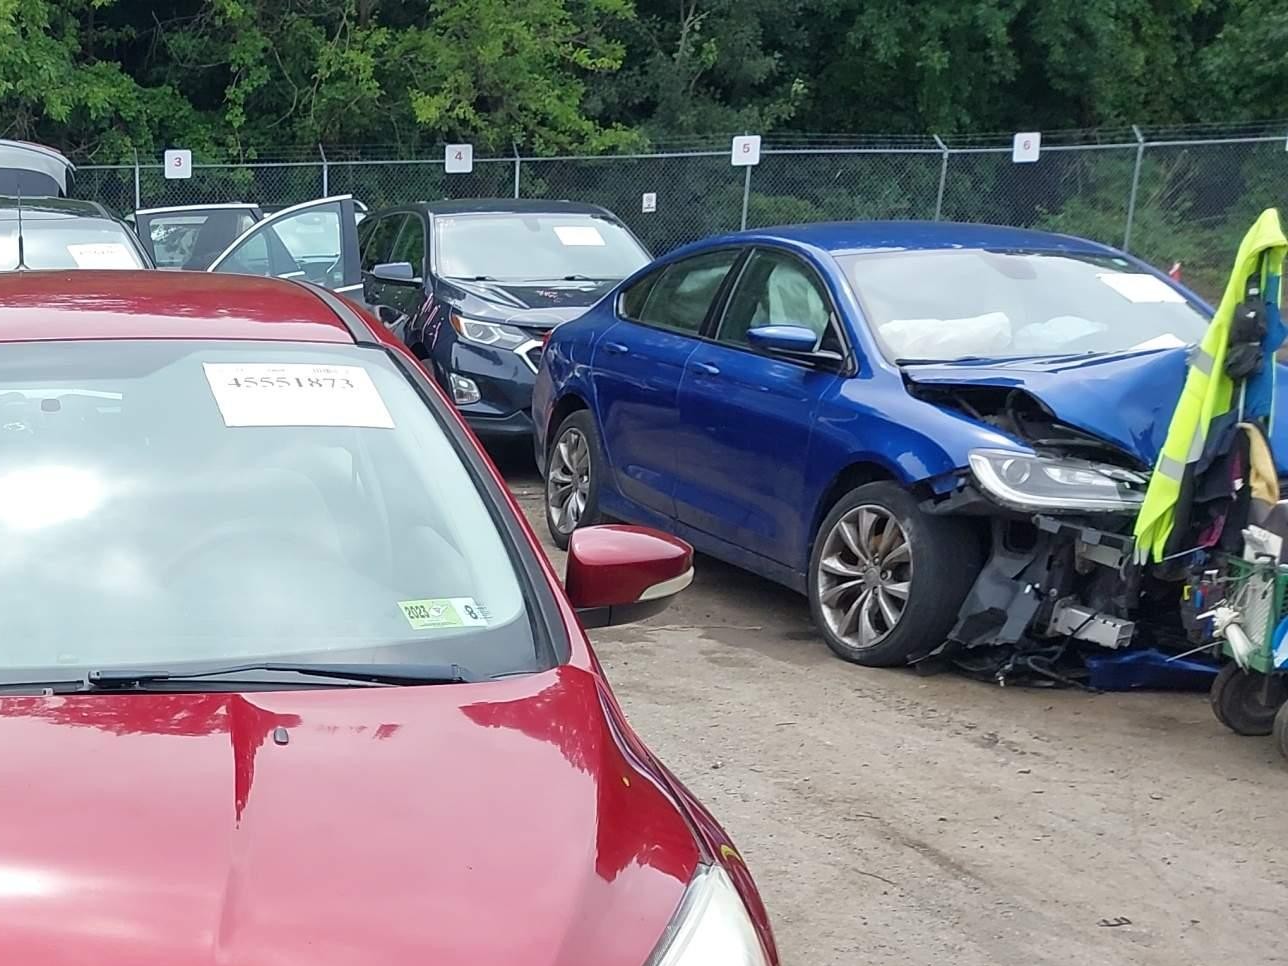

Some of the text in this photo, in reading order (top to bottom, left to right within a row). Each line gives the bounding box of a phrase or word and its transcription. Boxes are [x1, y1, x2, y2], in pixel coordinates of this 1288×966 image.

[743, 143, 751, 153] 5
[174, 156, 182, 168] 3
[454, 151, 464, 161] 4
[227, 376, 355, 389] 45551873
[404, 605, 430, 620] 2023
